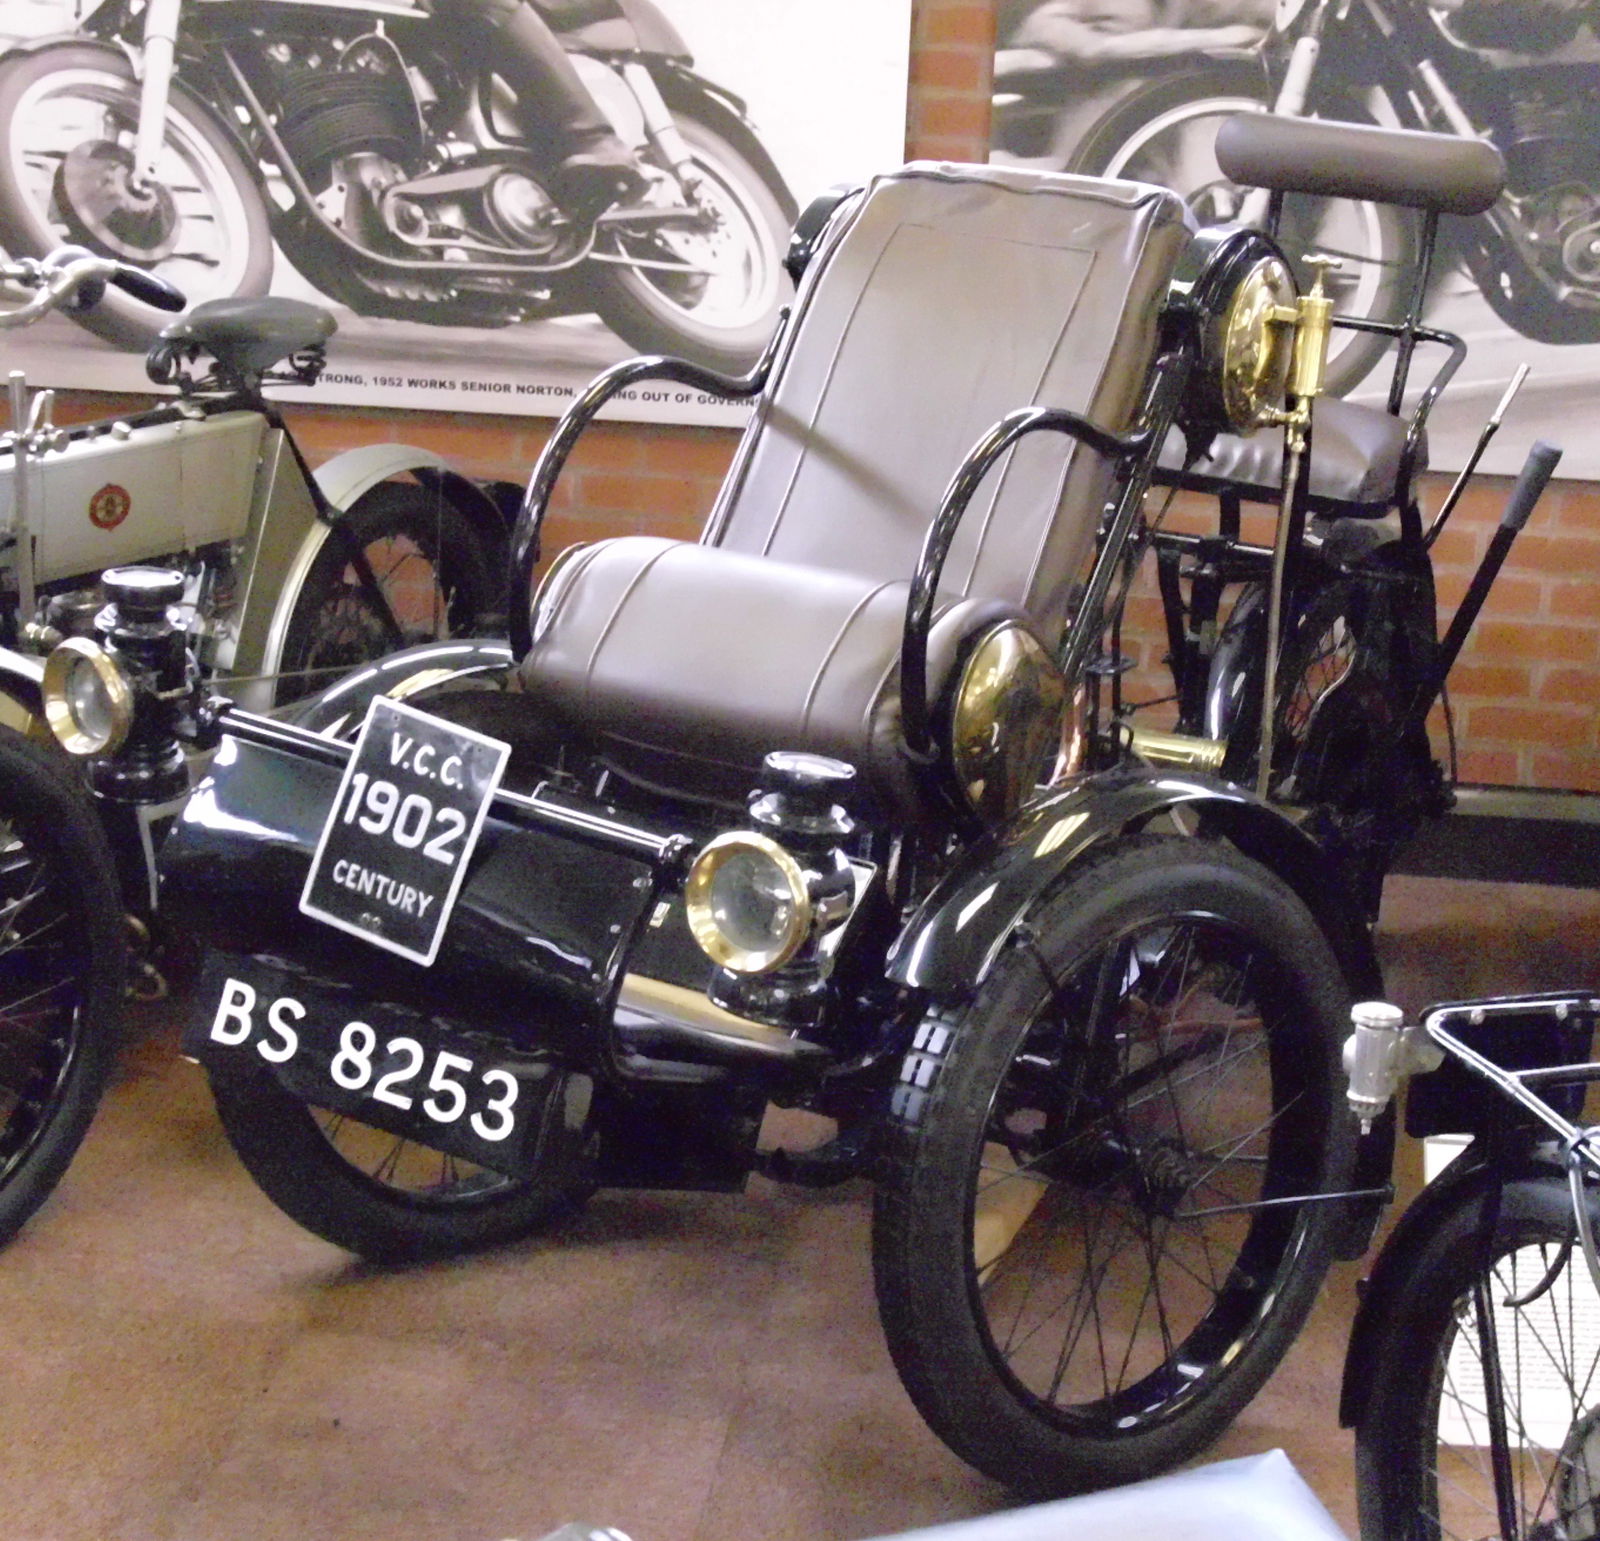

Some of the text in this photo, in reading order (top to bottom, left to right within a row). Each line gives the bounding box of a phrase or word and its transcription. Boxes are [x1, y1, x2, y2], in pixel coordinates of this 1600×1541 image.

[318, 373, 757, 408] TRONG, 1952 WORKS SENIOR NORTON, ING OUT OF GOVERN
[390, 732, 464, 790] V.C.C.
[344, 773, 466, 865] 1902
[333, 859, 434, 918] CENTURY
[210, 978, 519, 1142] BS 8253
